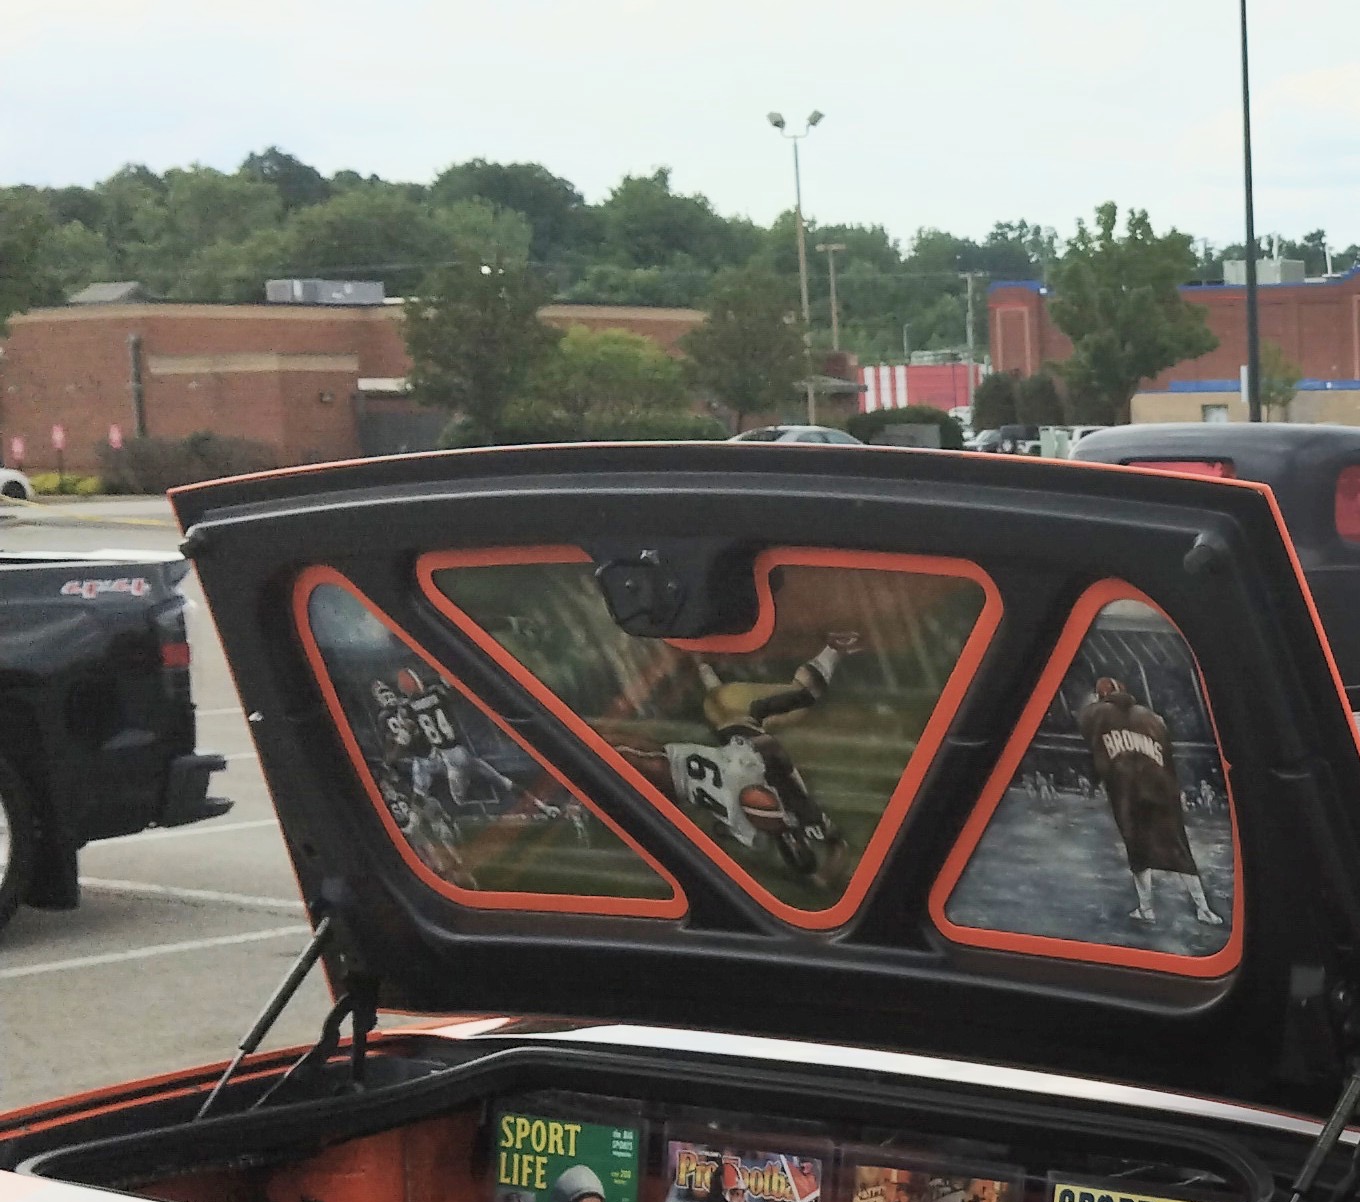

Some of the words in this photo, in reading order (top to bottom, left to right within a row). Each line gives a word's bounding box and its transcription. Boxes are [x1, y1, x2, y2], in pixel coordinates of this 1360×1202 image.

[1102, 729, 1164, 767] BROWNS
[501, 1115, 582, 1157] SPORT
[499, 1151, 548, 1190] LIFE
